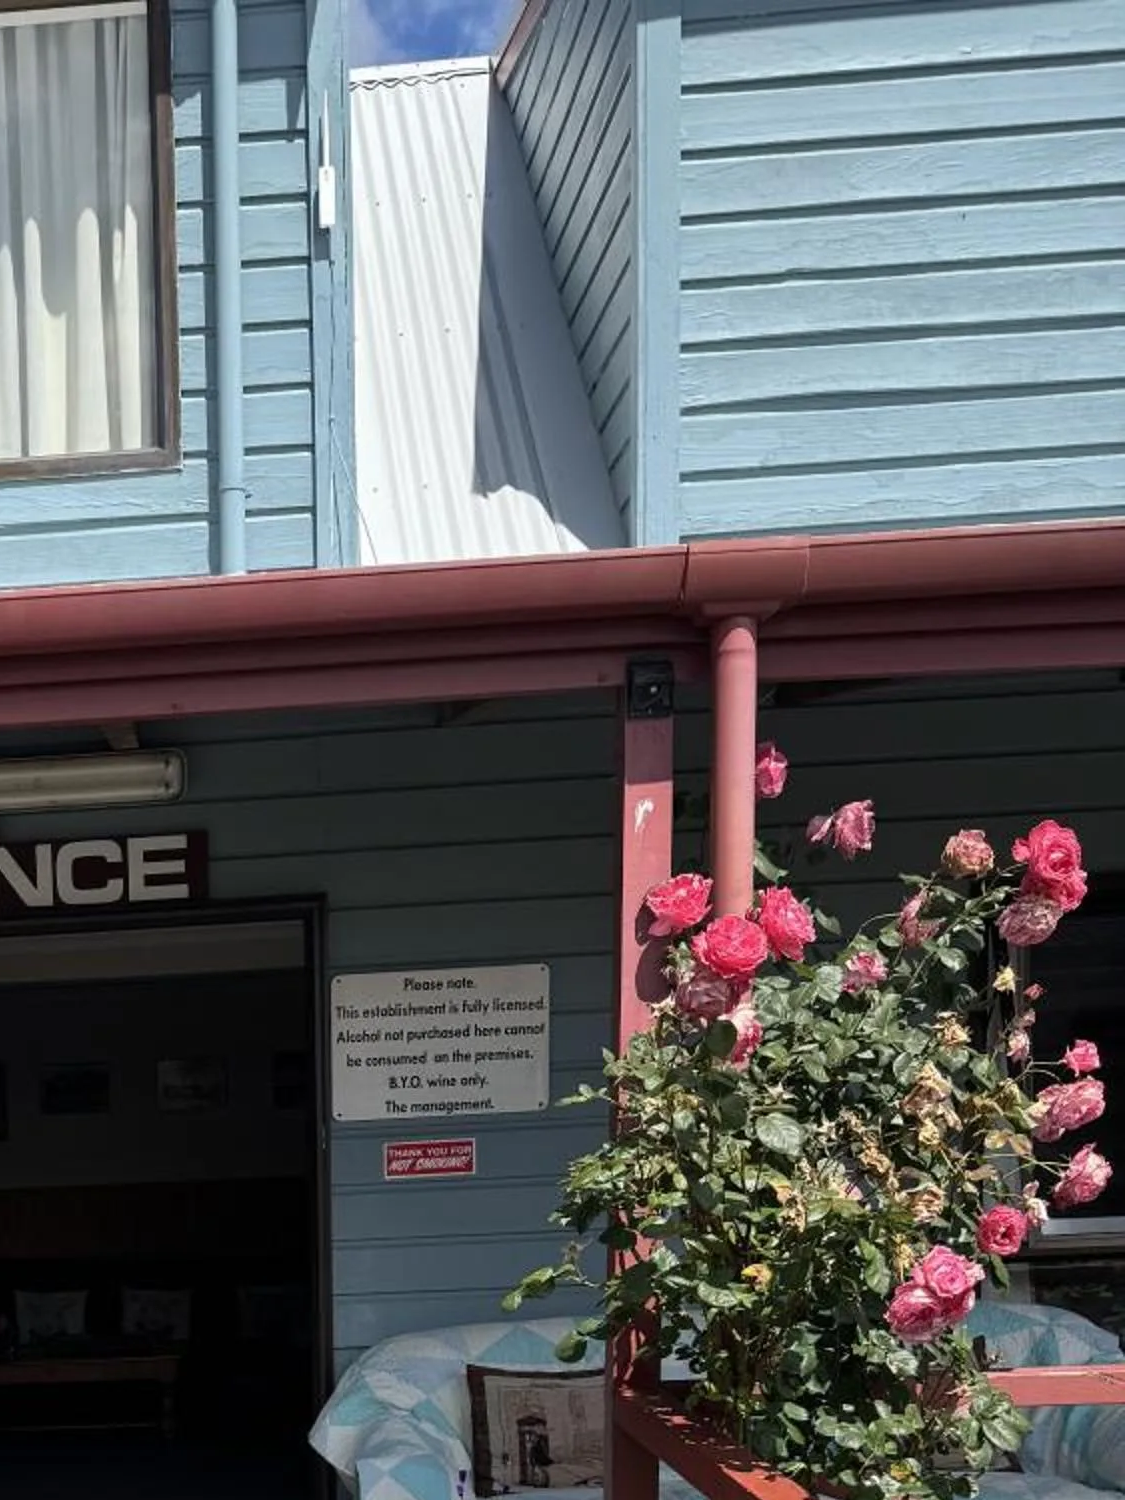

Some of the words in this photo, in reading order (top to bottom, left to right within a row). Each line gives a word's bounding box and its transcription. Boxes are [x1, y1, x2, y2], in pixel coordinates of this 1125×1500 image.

[403, 978, 443, 991] Please
[336, 1005, 360, 1019] This
[363, 1001, 445, 1018] establishment
[448, 1001, 459, 1014] is
[462, 999, 490, 1016] fully
[336, 1029, 381, 1044] Alcohol
[384, 1029, 404, 1041] not
[407, 1024, 470, 1044] purchased
[474, 1023, 501, 1037] here
[504, 1023, 546, 1036] cannot
[347, 1053, 362, 1067] be
[365, 1050, 428, 1067] consumed
[452, 1048, 472, 1062] the
[475, 1046, 534, 1064] premises.
[389, 1075, 424, 1089] B.Y.O.
[427, 1073, 456, 1088] wine
[460, 1073, 490, 1089] only.
[385, 1100, 408, 1113] The
[410, 1098, 495, 1115] management.
[389, 1147, 423, 1158] THANK
[426, 1146, 448, 1156] YOU
[450, 1144, 472, 1155] FOR
